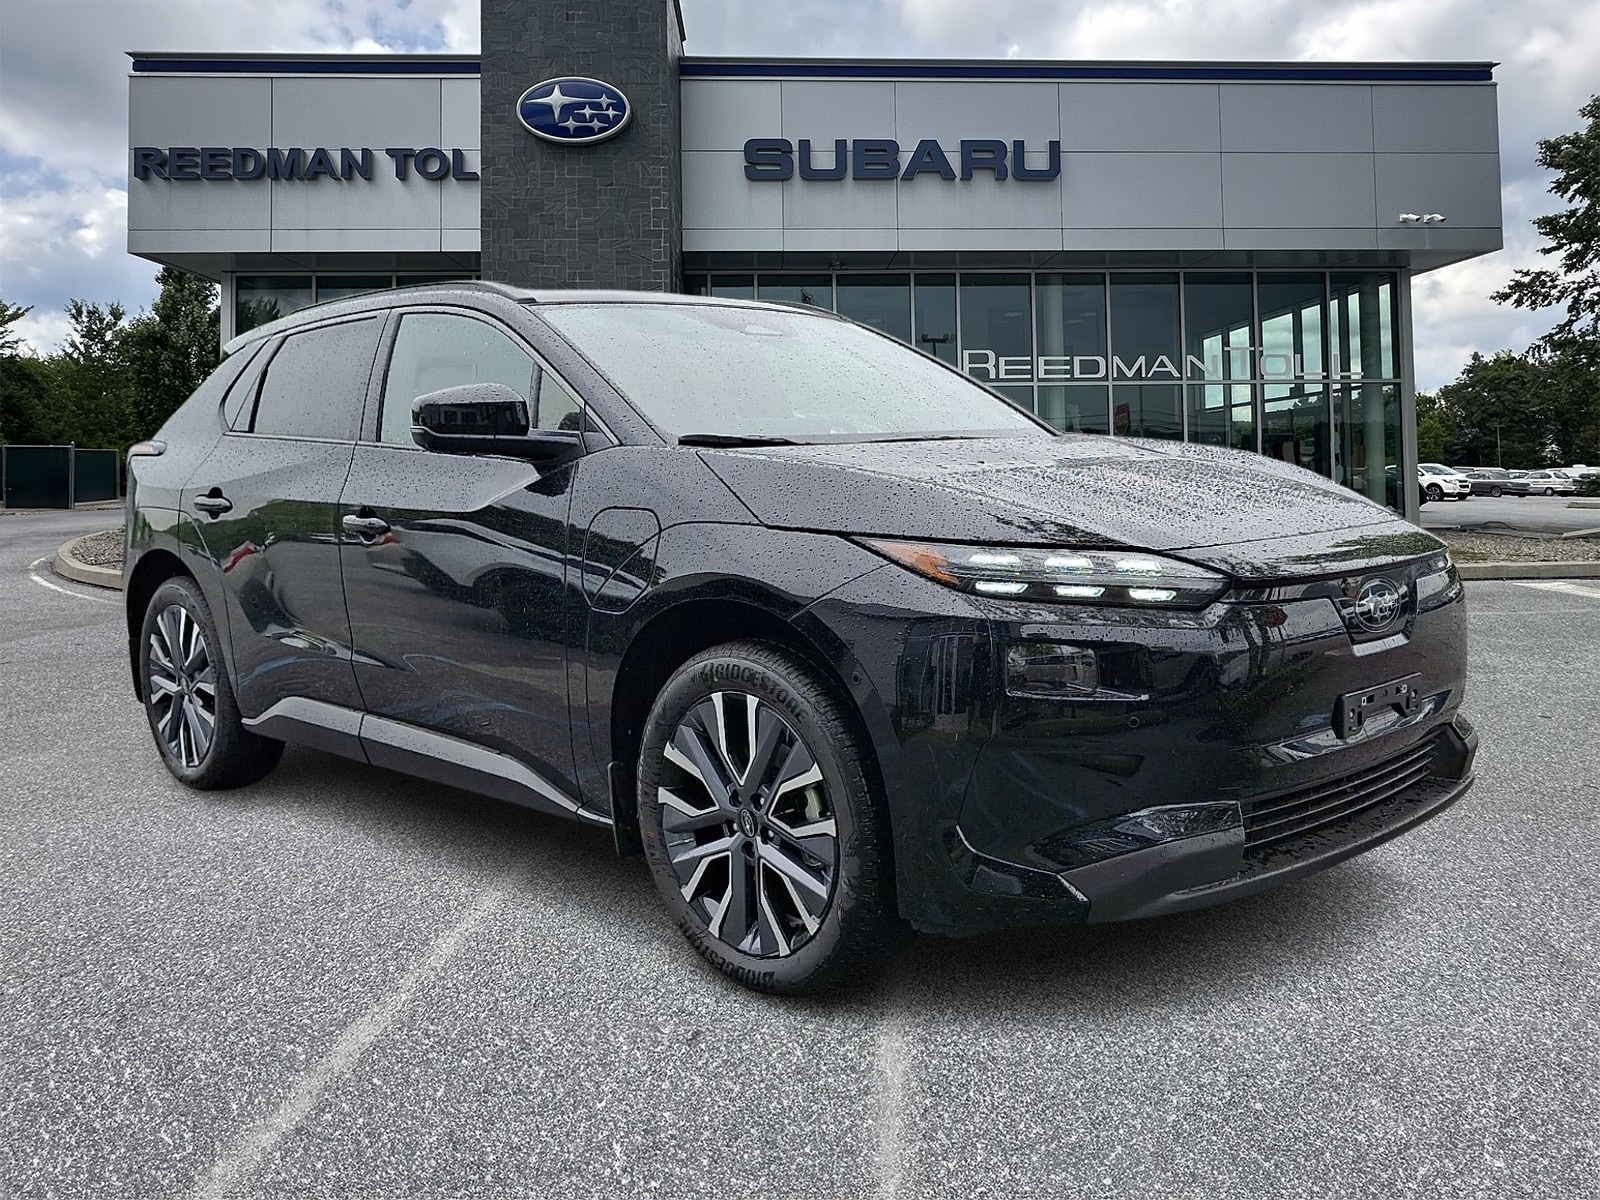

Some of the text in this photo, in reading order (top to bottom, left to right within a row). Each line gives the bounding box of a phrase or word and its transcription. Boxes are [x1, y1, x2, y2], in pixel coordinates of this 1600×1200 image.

[133, 147, 480, 181] REEDMAN TOL
[743, 138, 1061, 181] SUBARU
[962, 346, 1364, 379] REEDMAN TOLL
